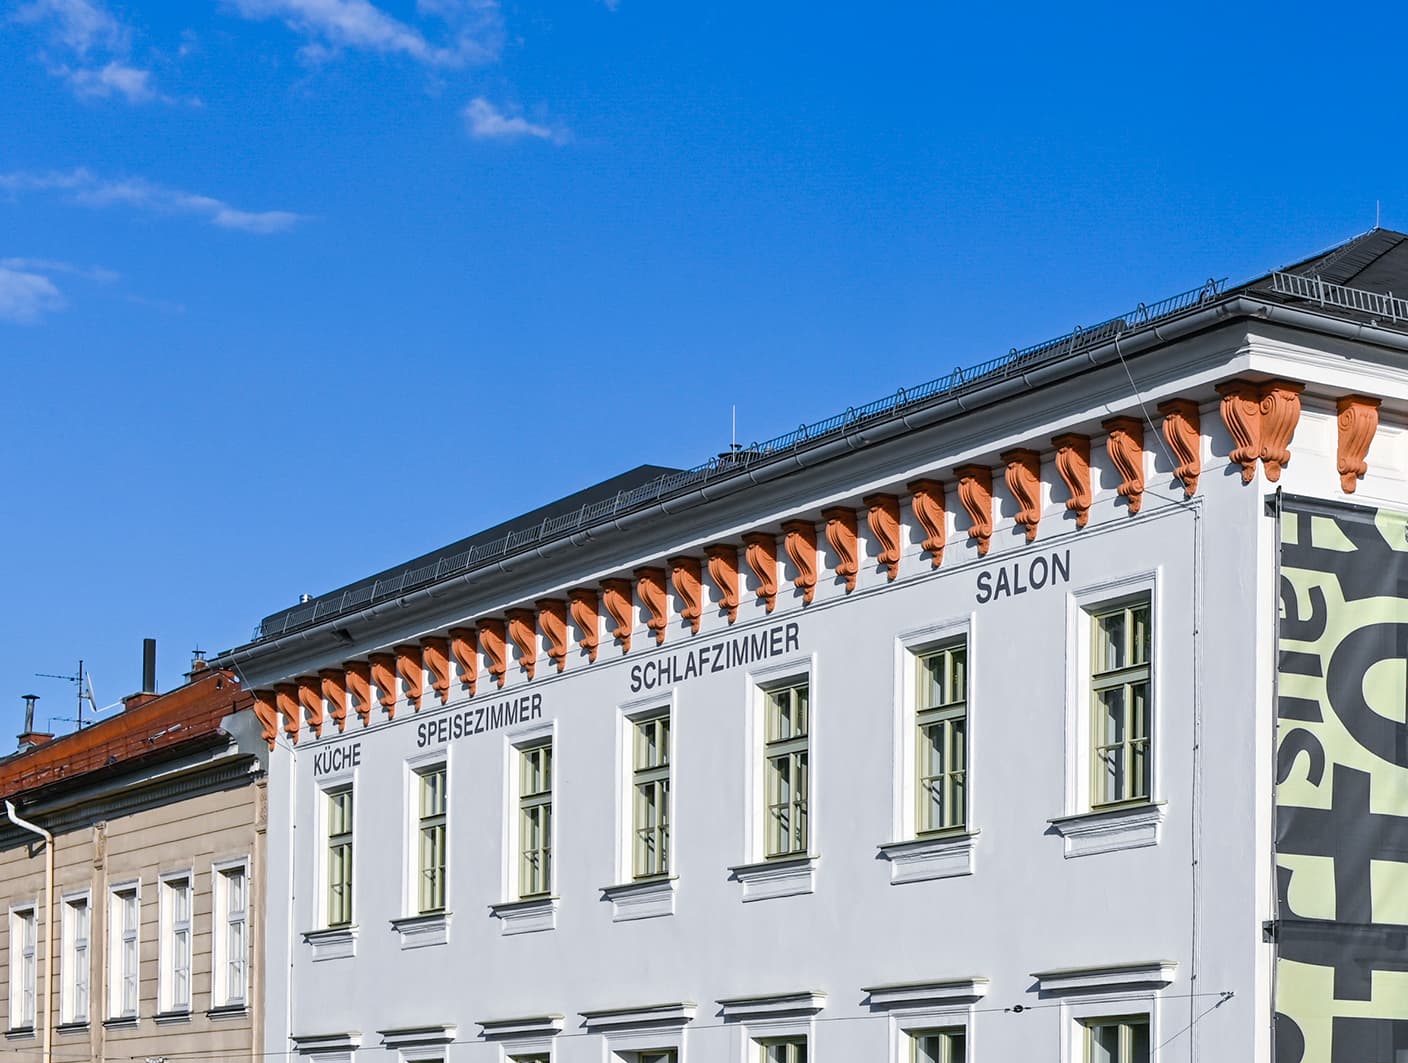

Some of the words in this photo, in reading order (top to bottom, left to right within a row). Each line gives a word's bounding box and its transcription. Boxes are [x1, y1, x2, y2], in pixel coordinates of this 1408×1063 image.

[976, 550, 1070, 604] SALON
[630, 622, 800, 693] SCHLAFZIMMER
[416, 693, 542, 748] SPEISEZIMMER
[313, 742, 361, 776] KÜCHE
